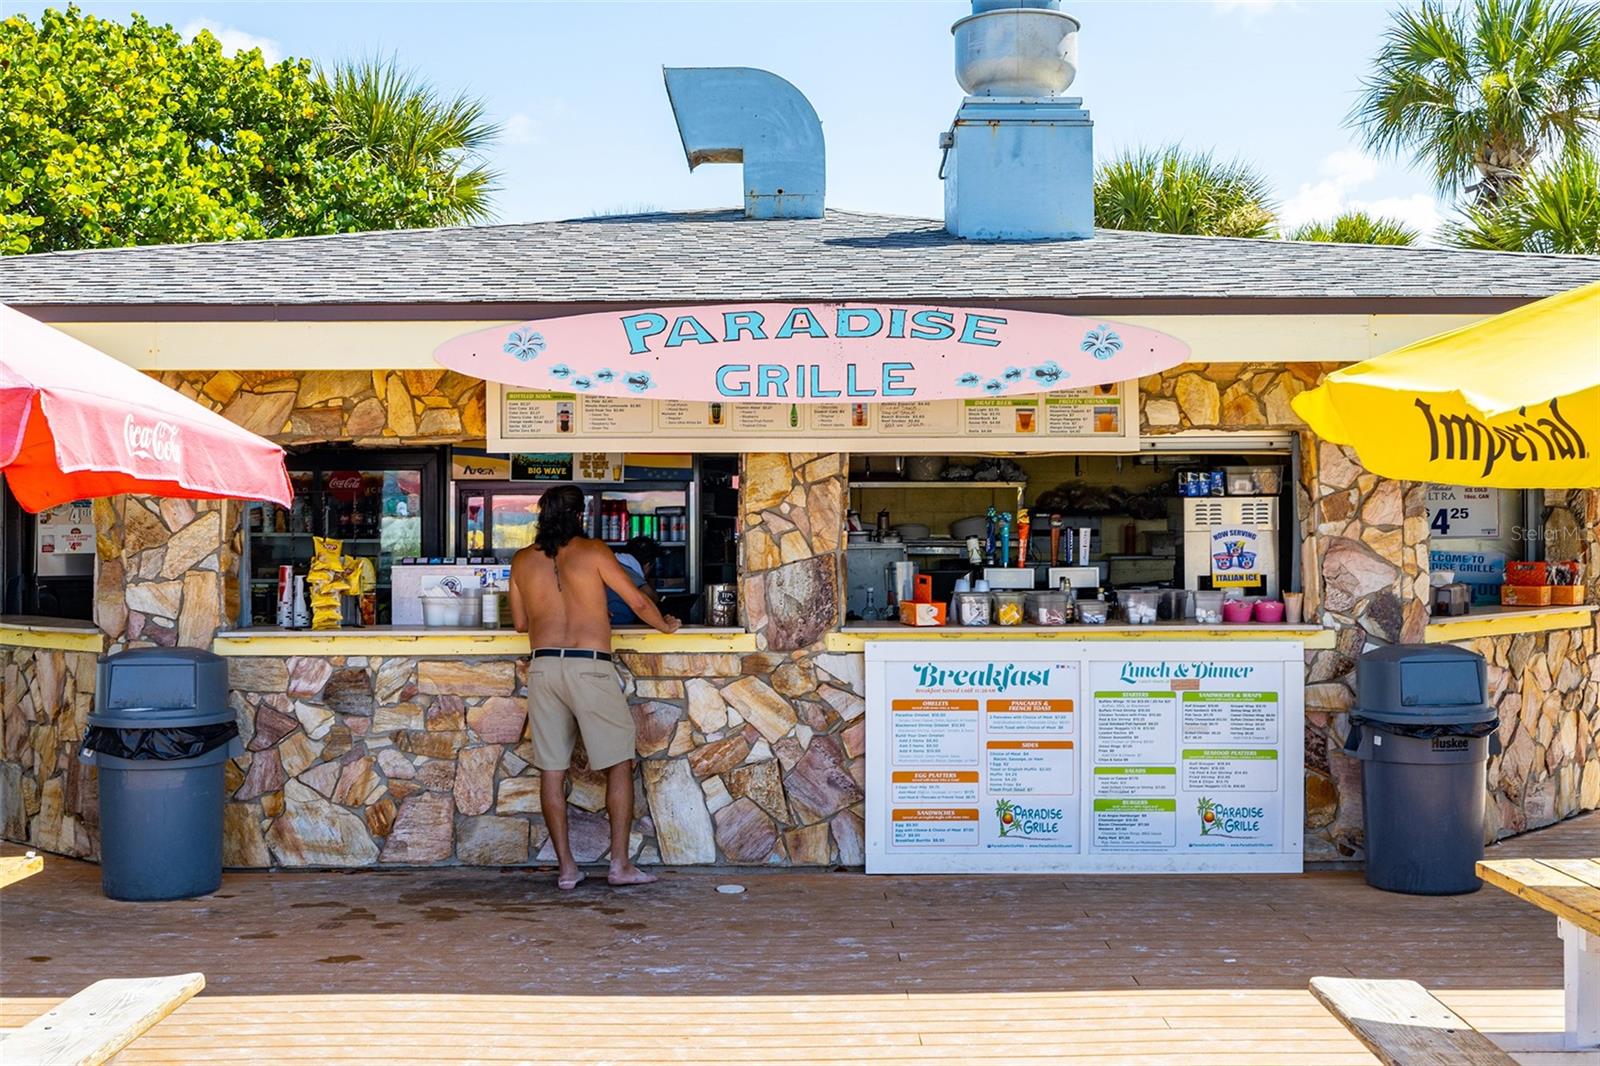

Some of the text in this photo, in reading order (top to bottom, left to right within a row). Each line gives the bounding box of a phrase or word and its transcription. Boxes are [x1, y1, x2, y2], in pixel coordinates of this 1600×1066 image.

[620, 307, 1008, 355] PARADISE
[715, 362, 917, 398] GRILLE
[1414, 397, 1586, 478] Imperial
[329, 477, 361, 488] Coca-Cola
[1213, 530, 1257, 541] NOW SERVING
[1429, 553, 1484, 563] LCOME TO
[1459, 564, 1495, 573] GRILLE
[913, 662, 1050, 692] Breakfast
[1120, 661, 1254, 684] Lunch & Dinner
[1432, 738, 1468, 748] Huskee
[1013, 805, 1063, 820] PARADISE
[1214, 804, 1264, 818] PARADISE
[1024, 820, 1059, 834] GRILLE
[1224, 819, 1260, 833] GRILLE
